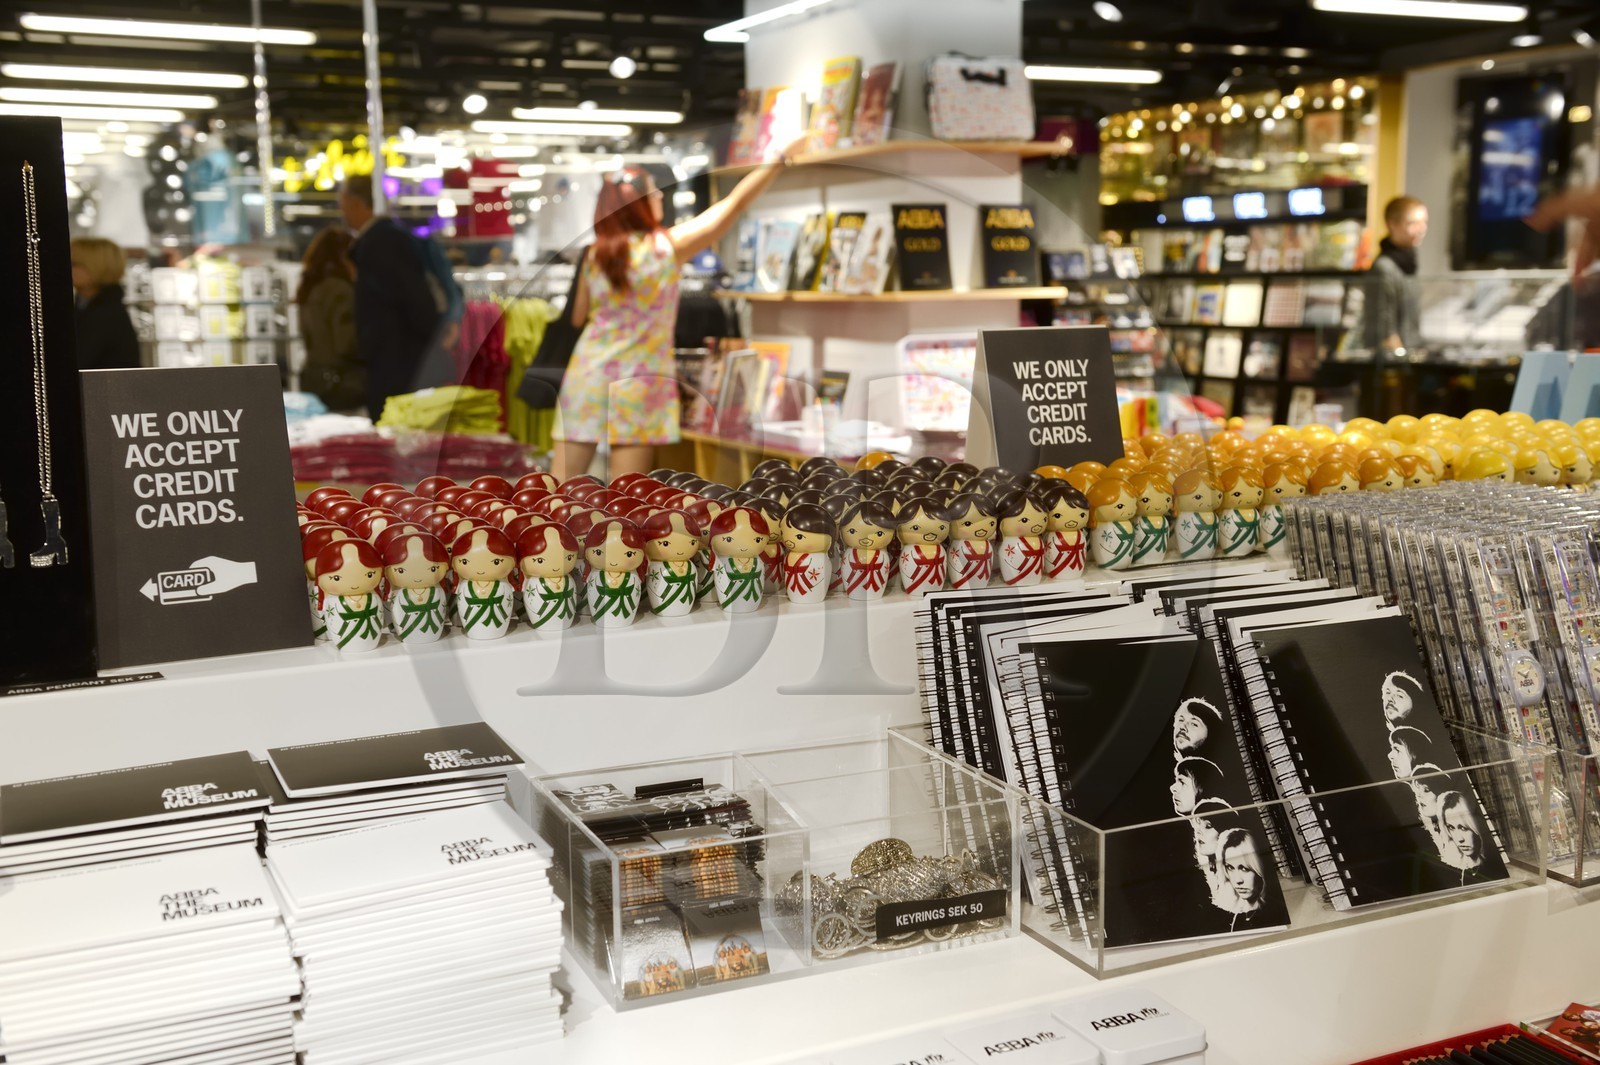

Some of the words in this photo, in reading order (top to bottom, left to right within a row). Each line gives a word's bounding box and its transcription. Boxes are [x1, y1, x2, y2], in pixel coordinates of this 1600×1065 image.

[1013, 361, 1041, 379] WE
[1044, 359, 1089, 378] ONLY
[1022, 381, 1087, 401] ACCEPT
[111, 413, 160, 438] WE
[166, 408, 243, 436] ONLY
[1027, 403, 1087, 423] CREDIT
[1029, 425, 1092, 446] CARDS.
[124, 439, 240, 468] ACCEPT
[133, 468, 239, 498] CREDIT
[135, 499, 244, 529] CARDS.
[163, 573, 205, 589] CARD
[7, 687, 43, 695] ABBA
[46, 680, 106, 691] PENDANT
[424, 748, 473, 761] ABBA
[428, 755, 513, 770] MUSEUM
[161, 782, 218, 798] ABBA
[163, 789, 258, 809] MUSEUM
[441, 837, 493, 853] ABBA
[447, 846, 482, 858] THE
[448, 842, 537, 865] MUSEUM
[160, 887, 219, 905] ABBA
[165, 898, 204, 911] THE
[162, 898, 263, 921] MUSEUM
[896, 909, 945, 926] KEYRINGS
[948, 905, 968, 917] SEK
[970, 902, 983, 914] 50
[1091, 1013, 1145, 1031] ABBA
[983, 1037, 1040, 1056] ABBA
